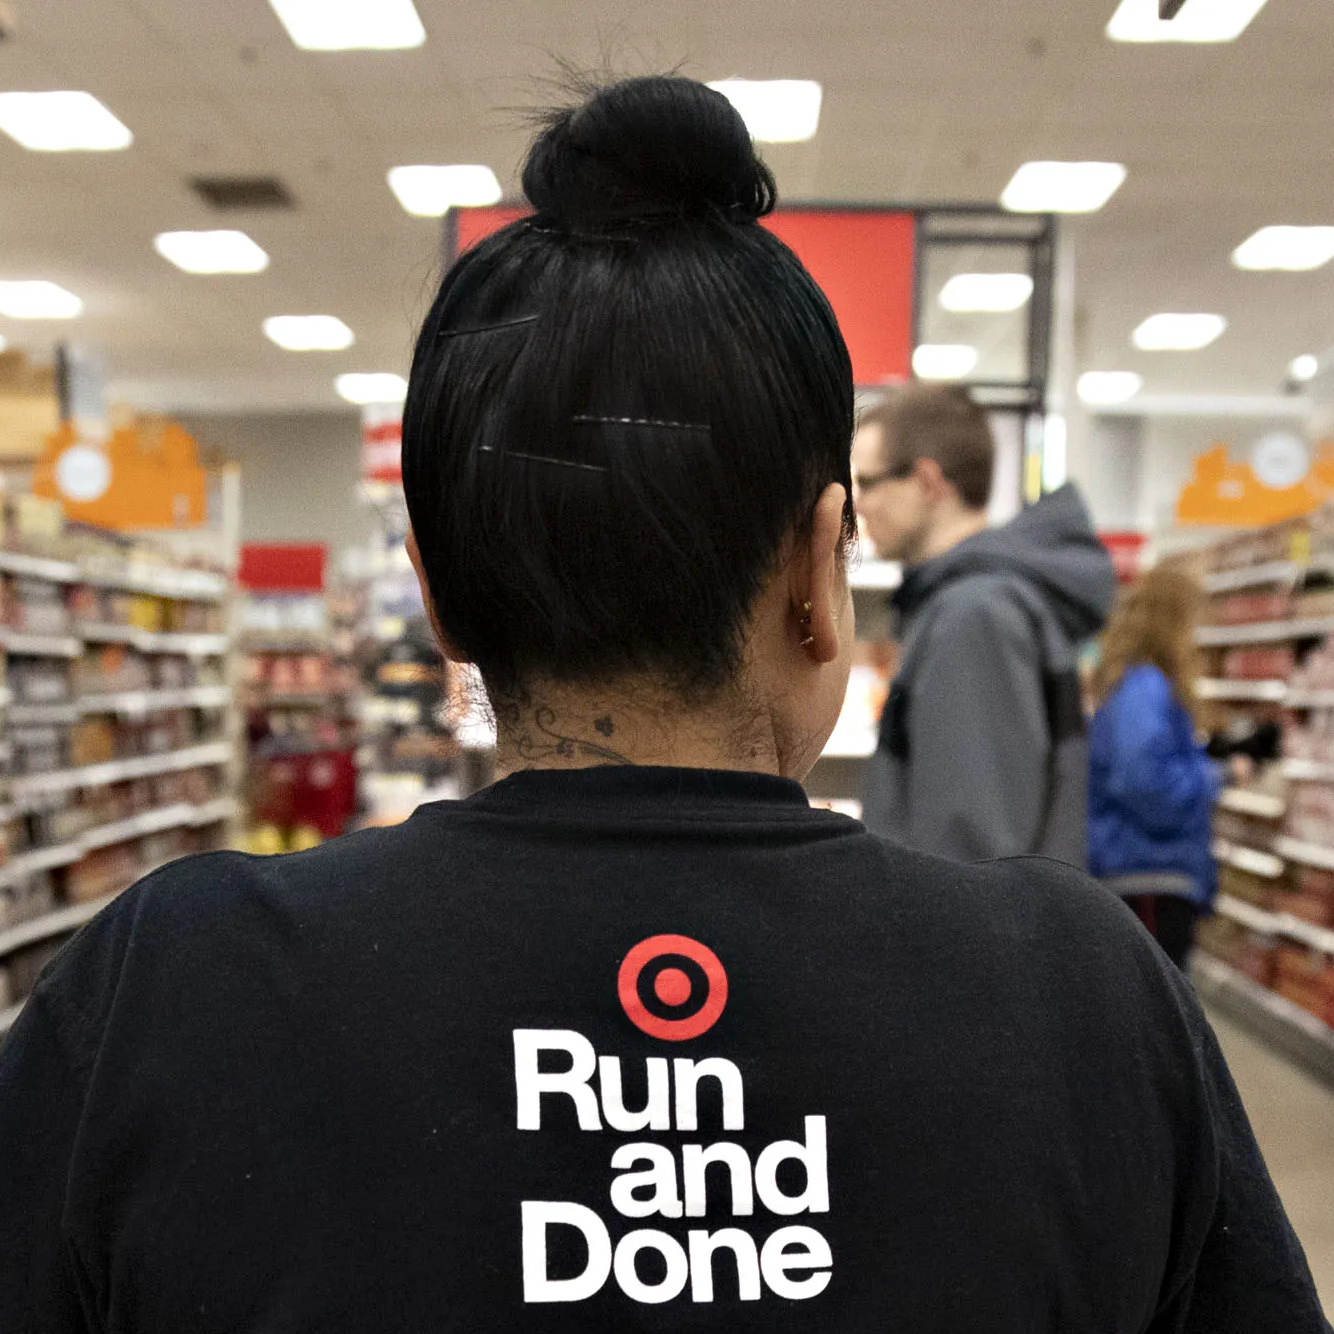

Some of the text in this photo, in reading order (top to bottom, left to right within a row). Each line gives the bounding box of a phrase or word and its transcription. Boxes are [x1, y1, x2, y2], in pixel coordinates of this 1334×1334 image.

[513, 1029, 744, 1131] Run
[610, 1115, 829, 1218] and
[521, 1201, 833, 1304] Done
